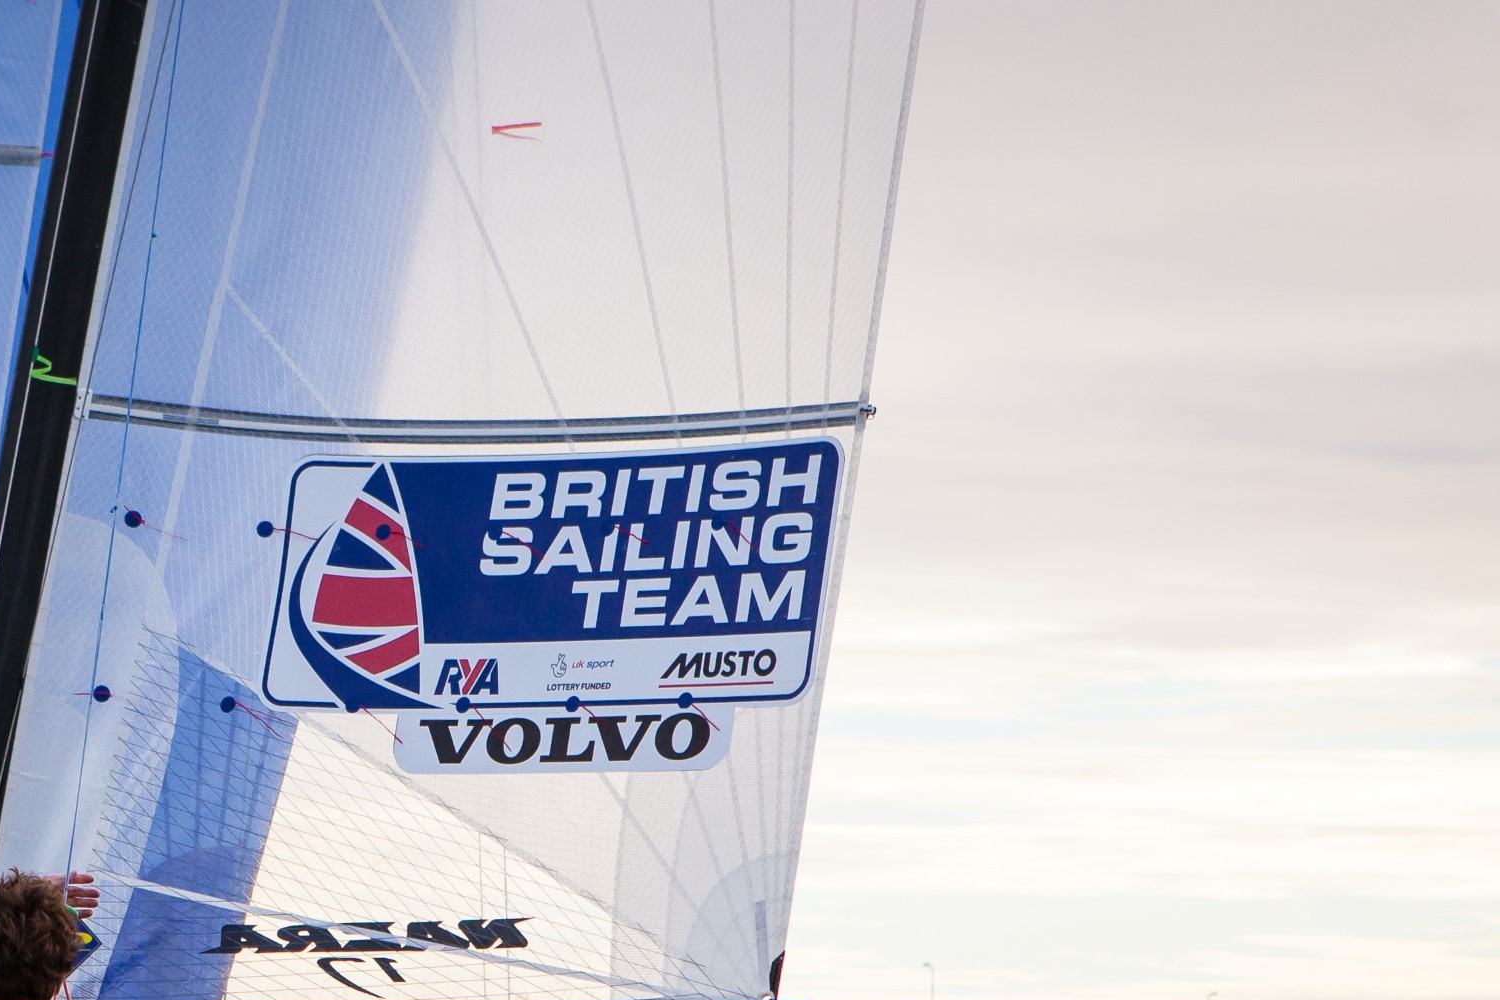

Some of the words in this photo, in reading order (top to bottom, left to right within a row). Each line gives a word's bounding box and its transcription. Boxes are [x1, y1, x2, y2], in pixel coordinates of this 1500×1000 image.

[488, 455, 824, 521] BRITISH
[480, 512, 814, 577] SAILING
[571, 570, 804, 629] TEAM
[434, 659, 499, 695] RYA
[572, 660, 584, 669] uk
[586, 659, 615, 671] sport
[659, 649, 776, 680] MUSTO
[546, 683, 580, 692] LOTTERY
[581, 682, 612, 691] FUNDED
[419, 712, 711, 765] VOLVO
